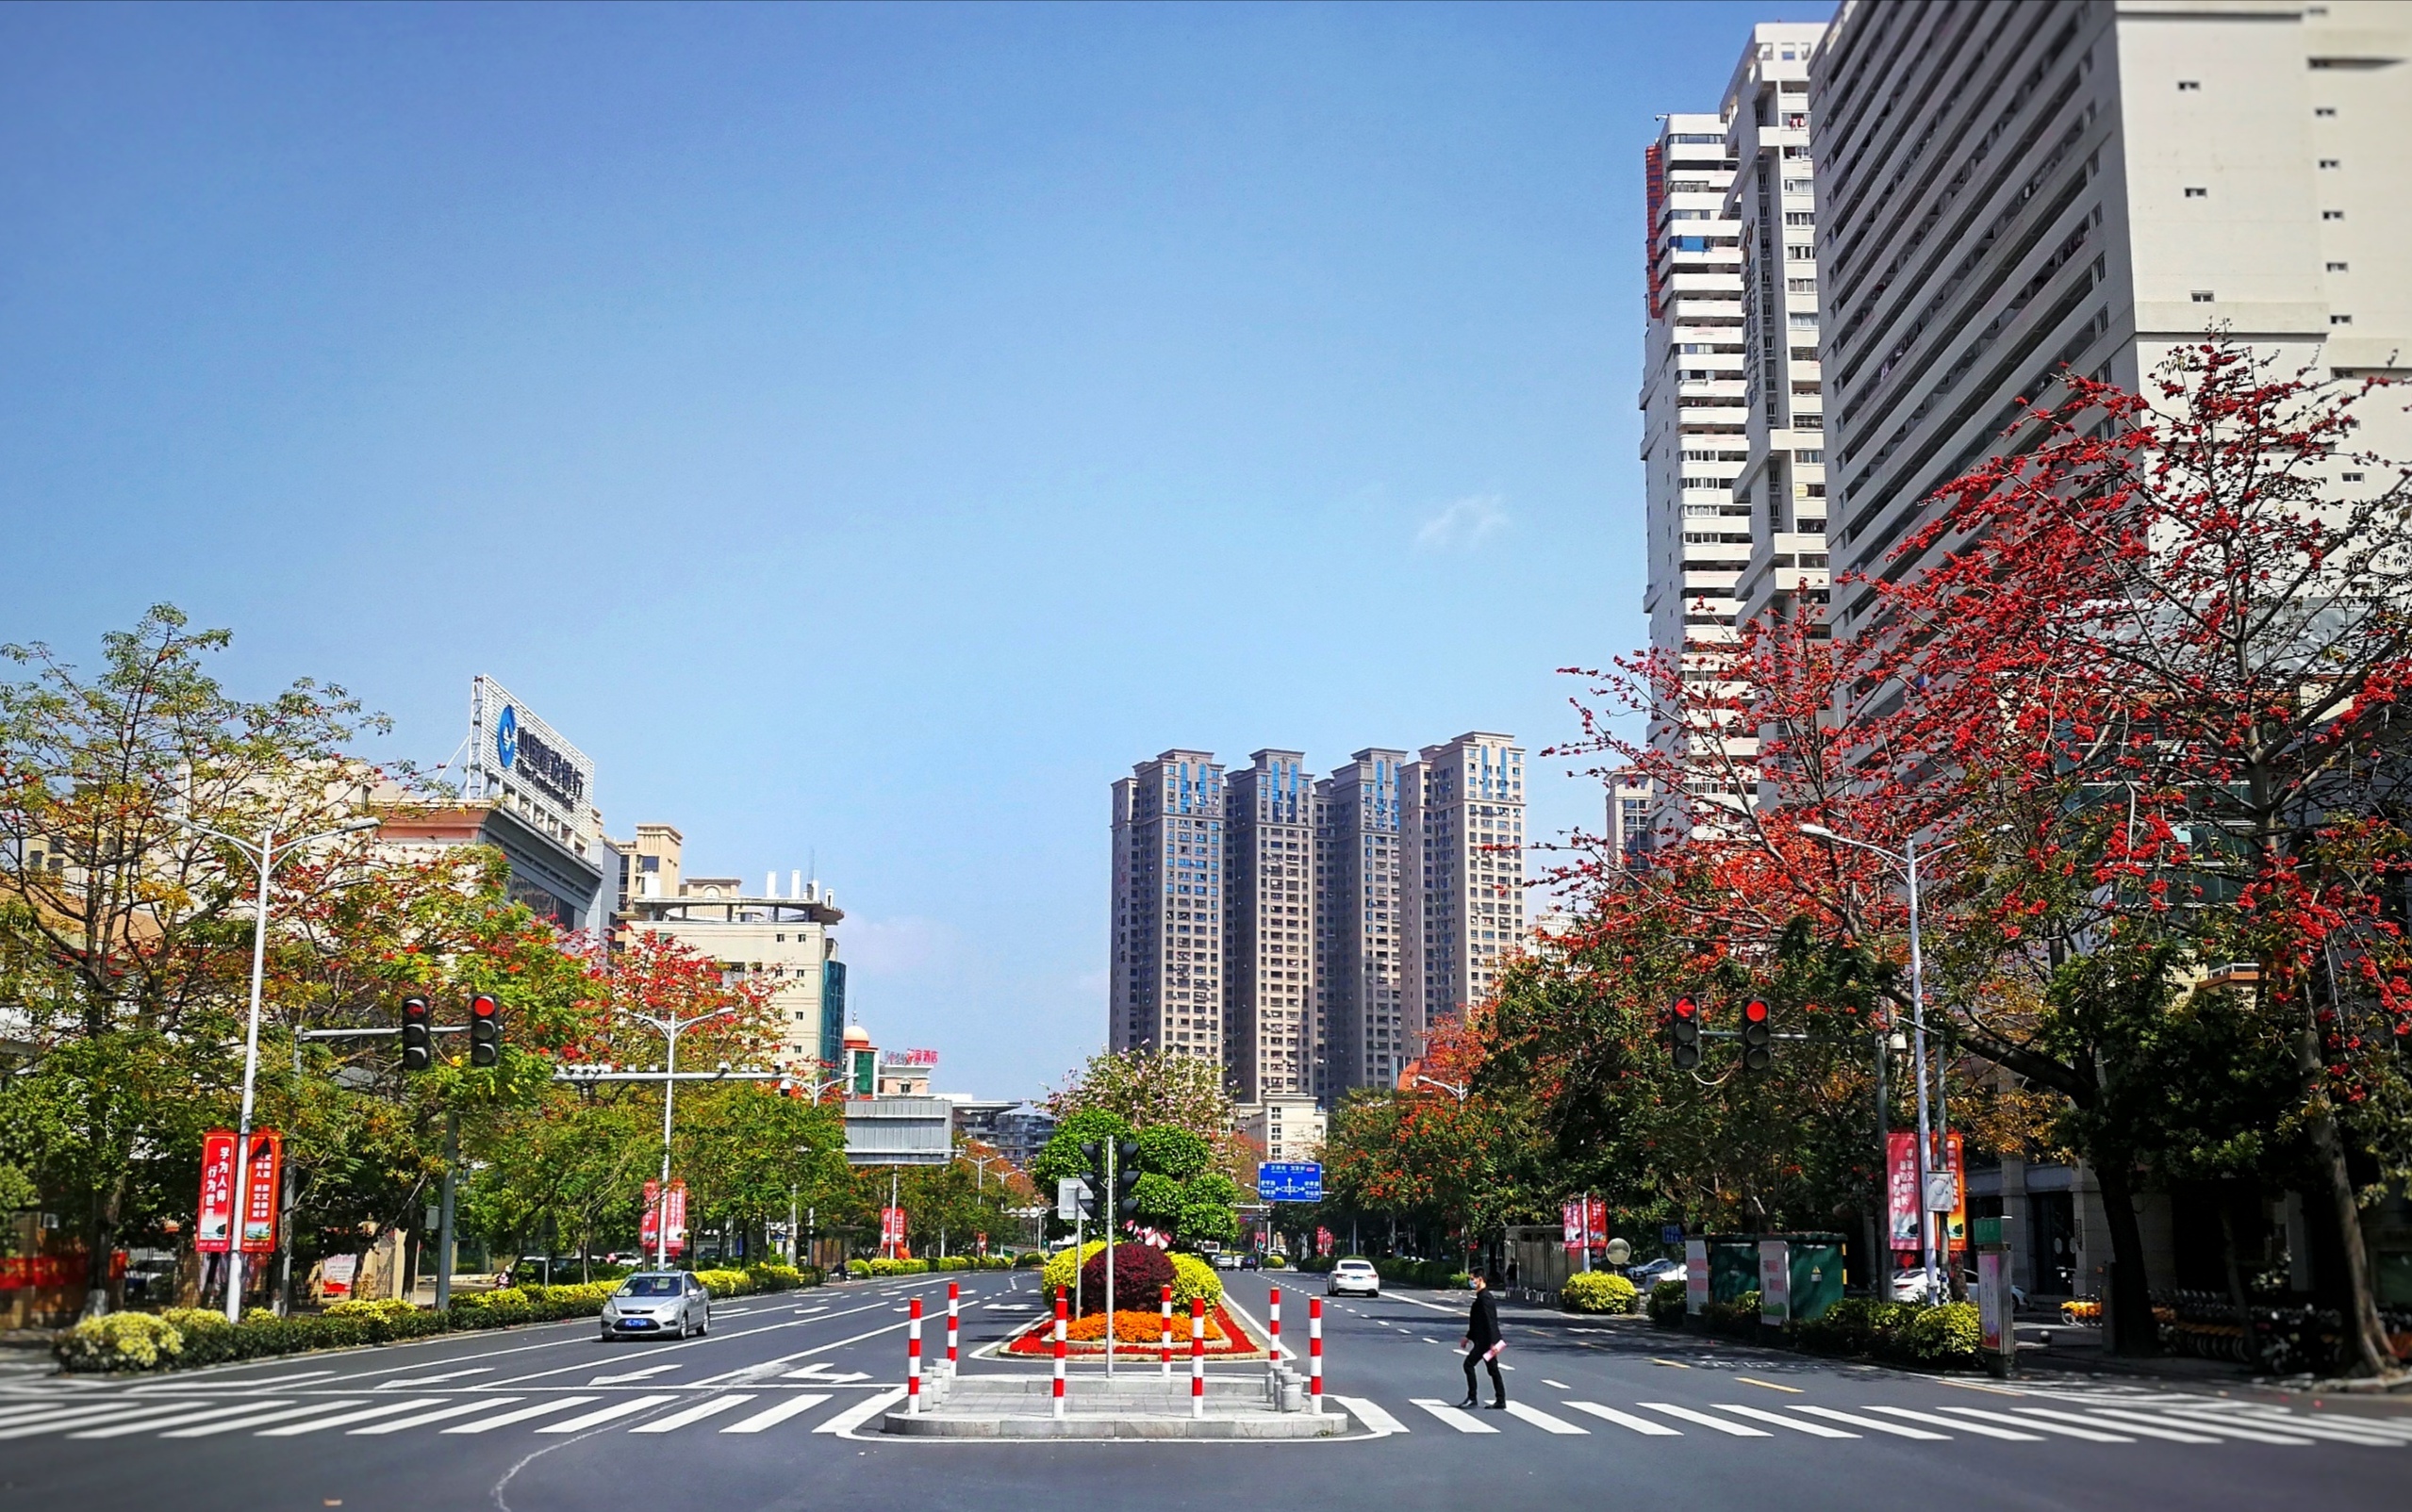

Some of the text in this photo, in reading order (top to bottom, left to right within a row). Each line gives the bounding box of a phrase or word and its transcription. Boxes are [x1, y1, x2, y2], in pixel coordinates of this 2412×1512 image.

[518, 727, 585, 800] 中国建设银行
[216, 1146, 230, 1202] 学为人师
